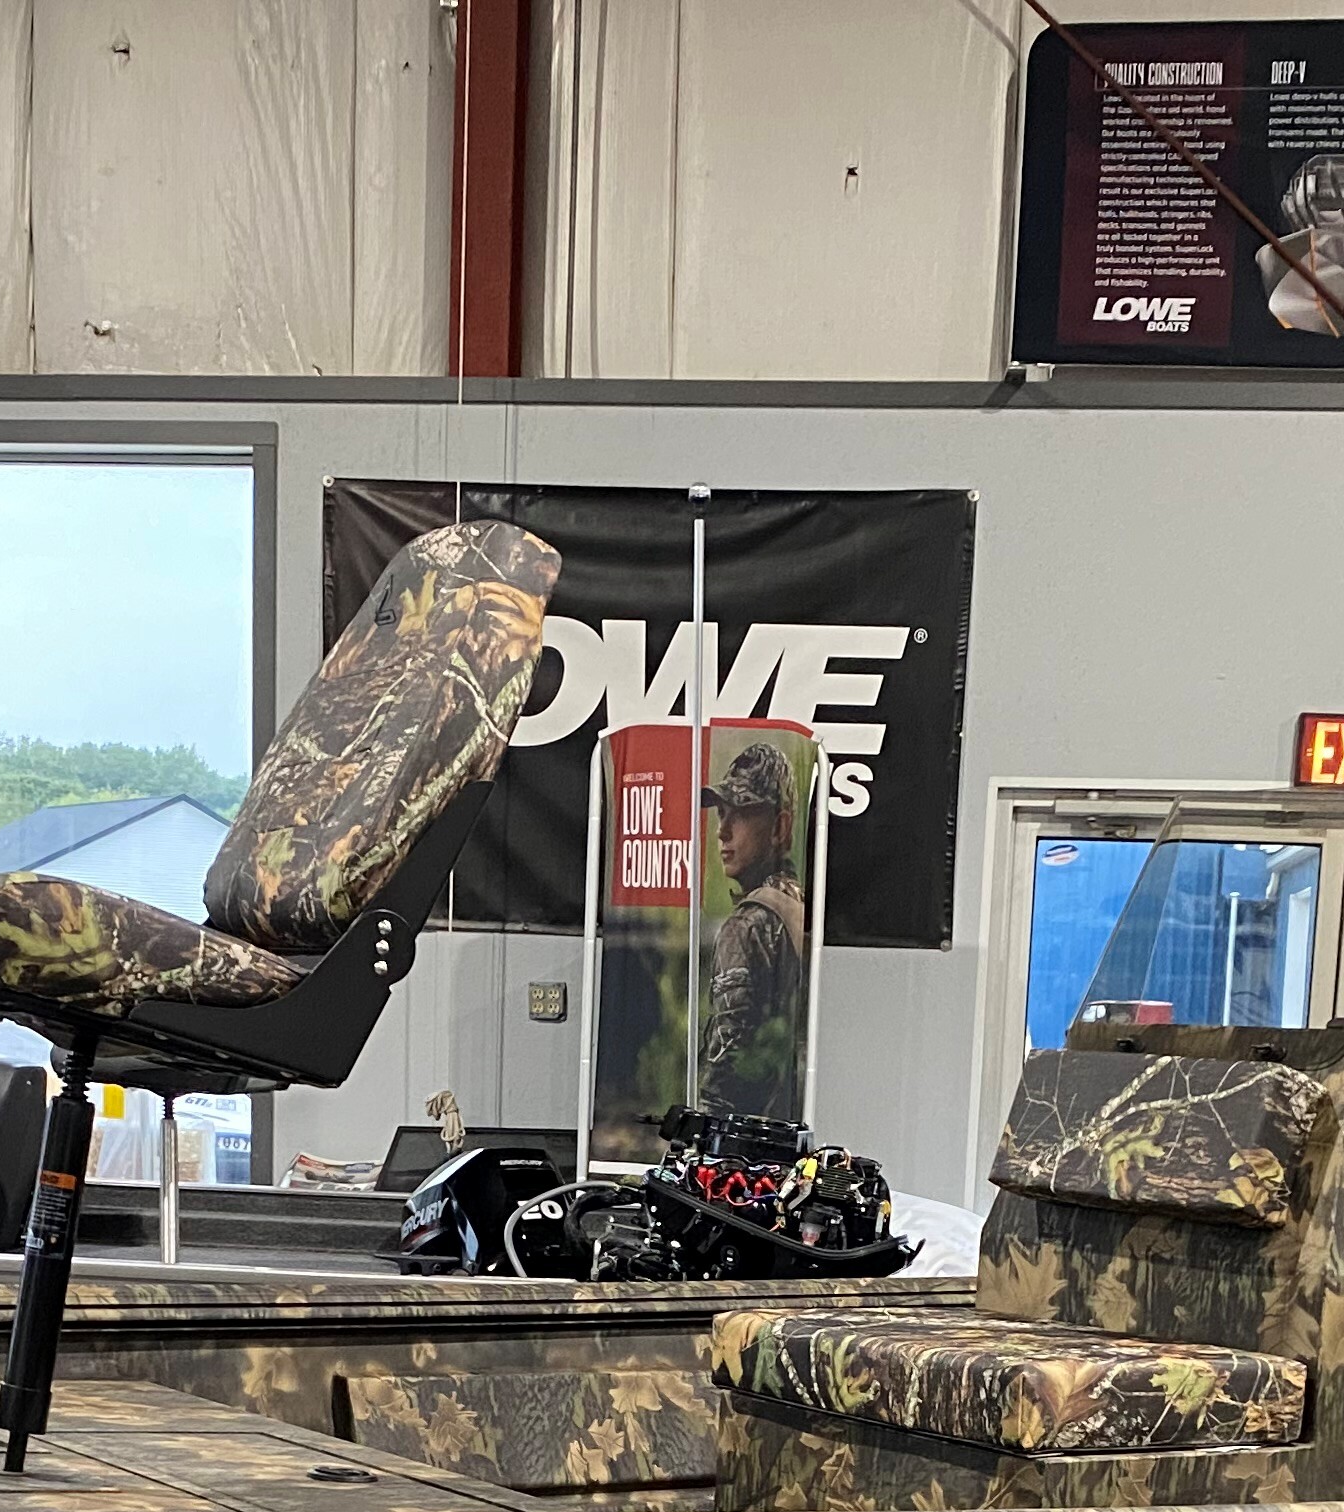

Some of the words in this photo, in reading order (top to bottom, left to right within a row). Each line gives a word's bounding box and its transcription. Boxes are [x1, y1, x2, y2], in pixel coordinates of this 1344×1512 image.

[1147, 62, 1224, 86] CONSTRUCTION
[1271, 60, 1306, 84] DEEP-V
[1093, 297, 1197, 321] LOWE
[1146, 322, 1189, 332] BOATS
[509, 615, 911, 755] OWE
[622, 786, 664, 835] LOWE
[622, 840, 692, 889] COUNTRY
[401, 1198, 449, 1242] ERCURY
